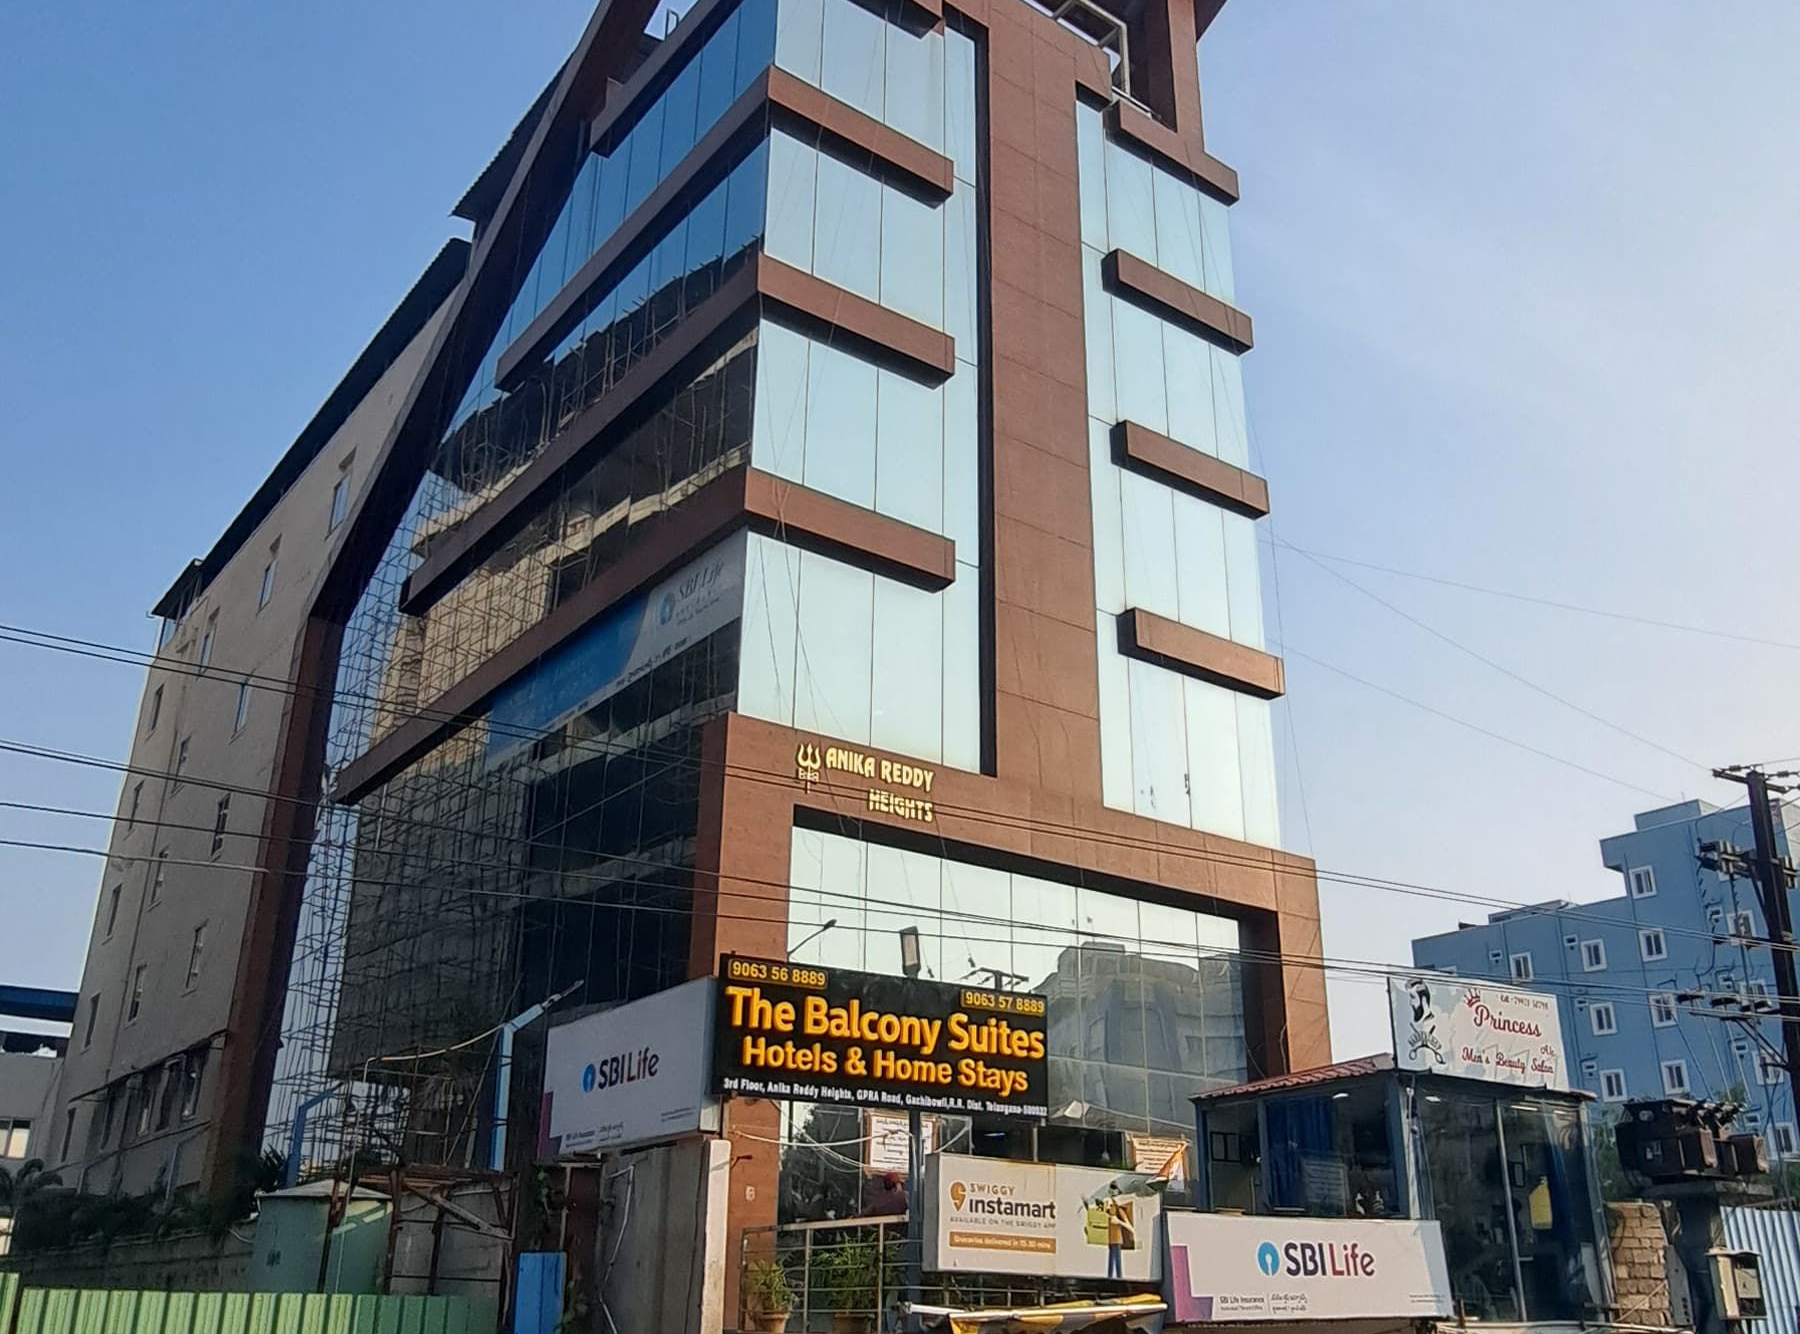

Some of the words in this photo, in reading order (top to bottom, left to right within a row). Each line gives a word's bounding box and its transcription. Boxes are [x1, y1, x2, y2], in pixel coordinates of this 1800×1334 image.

[825, 747, 876, 778] ANIKA
[881, 760, 935, 792] REDDY
[869, 789, 934, 822] HEIGHTS
[732, 961, 768, 979] 9063
[771, 966, 788, 981] 56
[792, 969, 826, 986] 8889
[966, 991, 995, 1007] 9063
[999, 996, 1013, 1009] 57
[1016, 998, 1045, 1013] 8889
[726, 985, 796, 1032] The
[804, 995, 942, 1055] Balcony
[948, 1012, 1045, 1059] Suites
[1473, 1004, 1542, 1037] Princess
[598, 1054, 625, 1089] SBI
[626, 1046, 660, 1082] Life
[743, 1035, 838, 1073] Hotels
[845, 1046, 867, 1076] &
[873, 1049, 952, 1084] Home
[958, 1058, 1029, 1097] Stays
[1462, 1046, 1490, 1064] Men's
[1495, 1052, 1527, 1075] Beauty
[1531, 1057, 1554, 1074] Salon
[723, 1077, 738, 1090] 3rd
[740, 1078, 765, 1093] Floor,
[767, 1081, 791, 1094] Anika
[793, 1083, 819, 1098] Reddy
[821, 1086, 855, 1101] Heights,
[857, 1088, 879, 1101] GPRA
[881, 1091, 903, 1105] Road,
[969, 1183, 1016, 1197] SWIGGY
[949, 1216, 987, 1225] AVAILABLE
[988, 1218, 999, 1226] ON
[1016, 1220, 1041, 1228] SWIGGY
[969, 1197, 1056, 1219] instamart
[1284, 1242, 1327, 1276] SBI
[1328, 1242, 1375, 1276] Life
